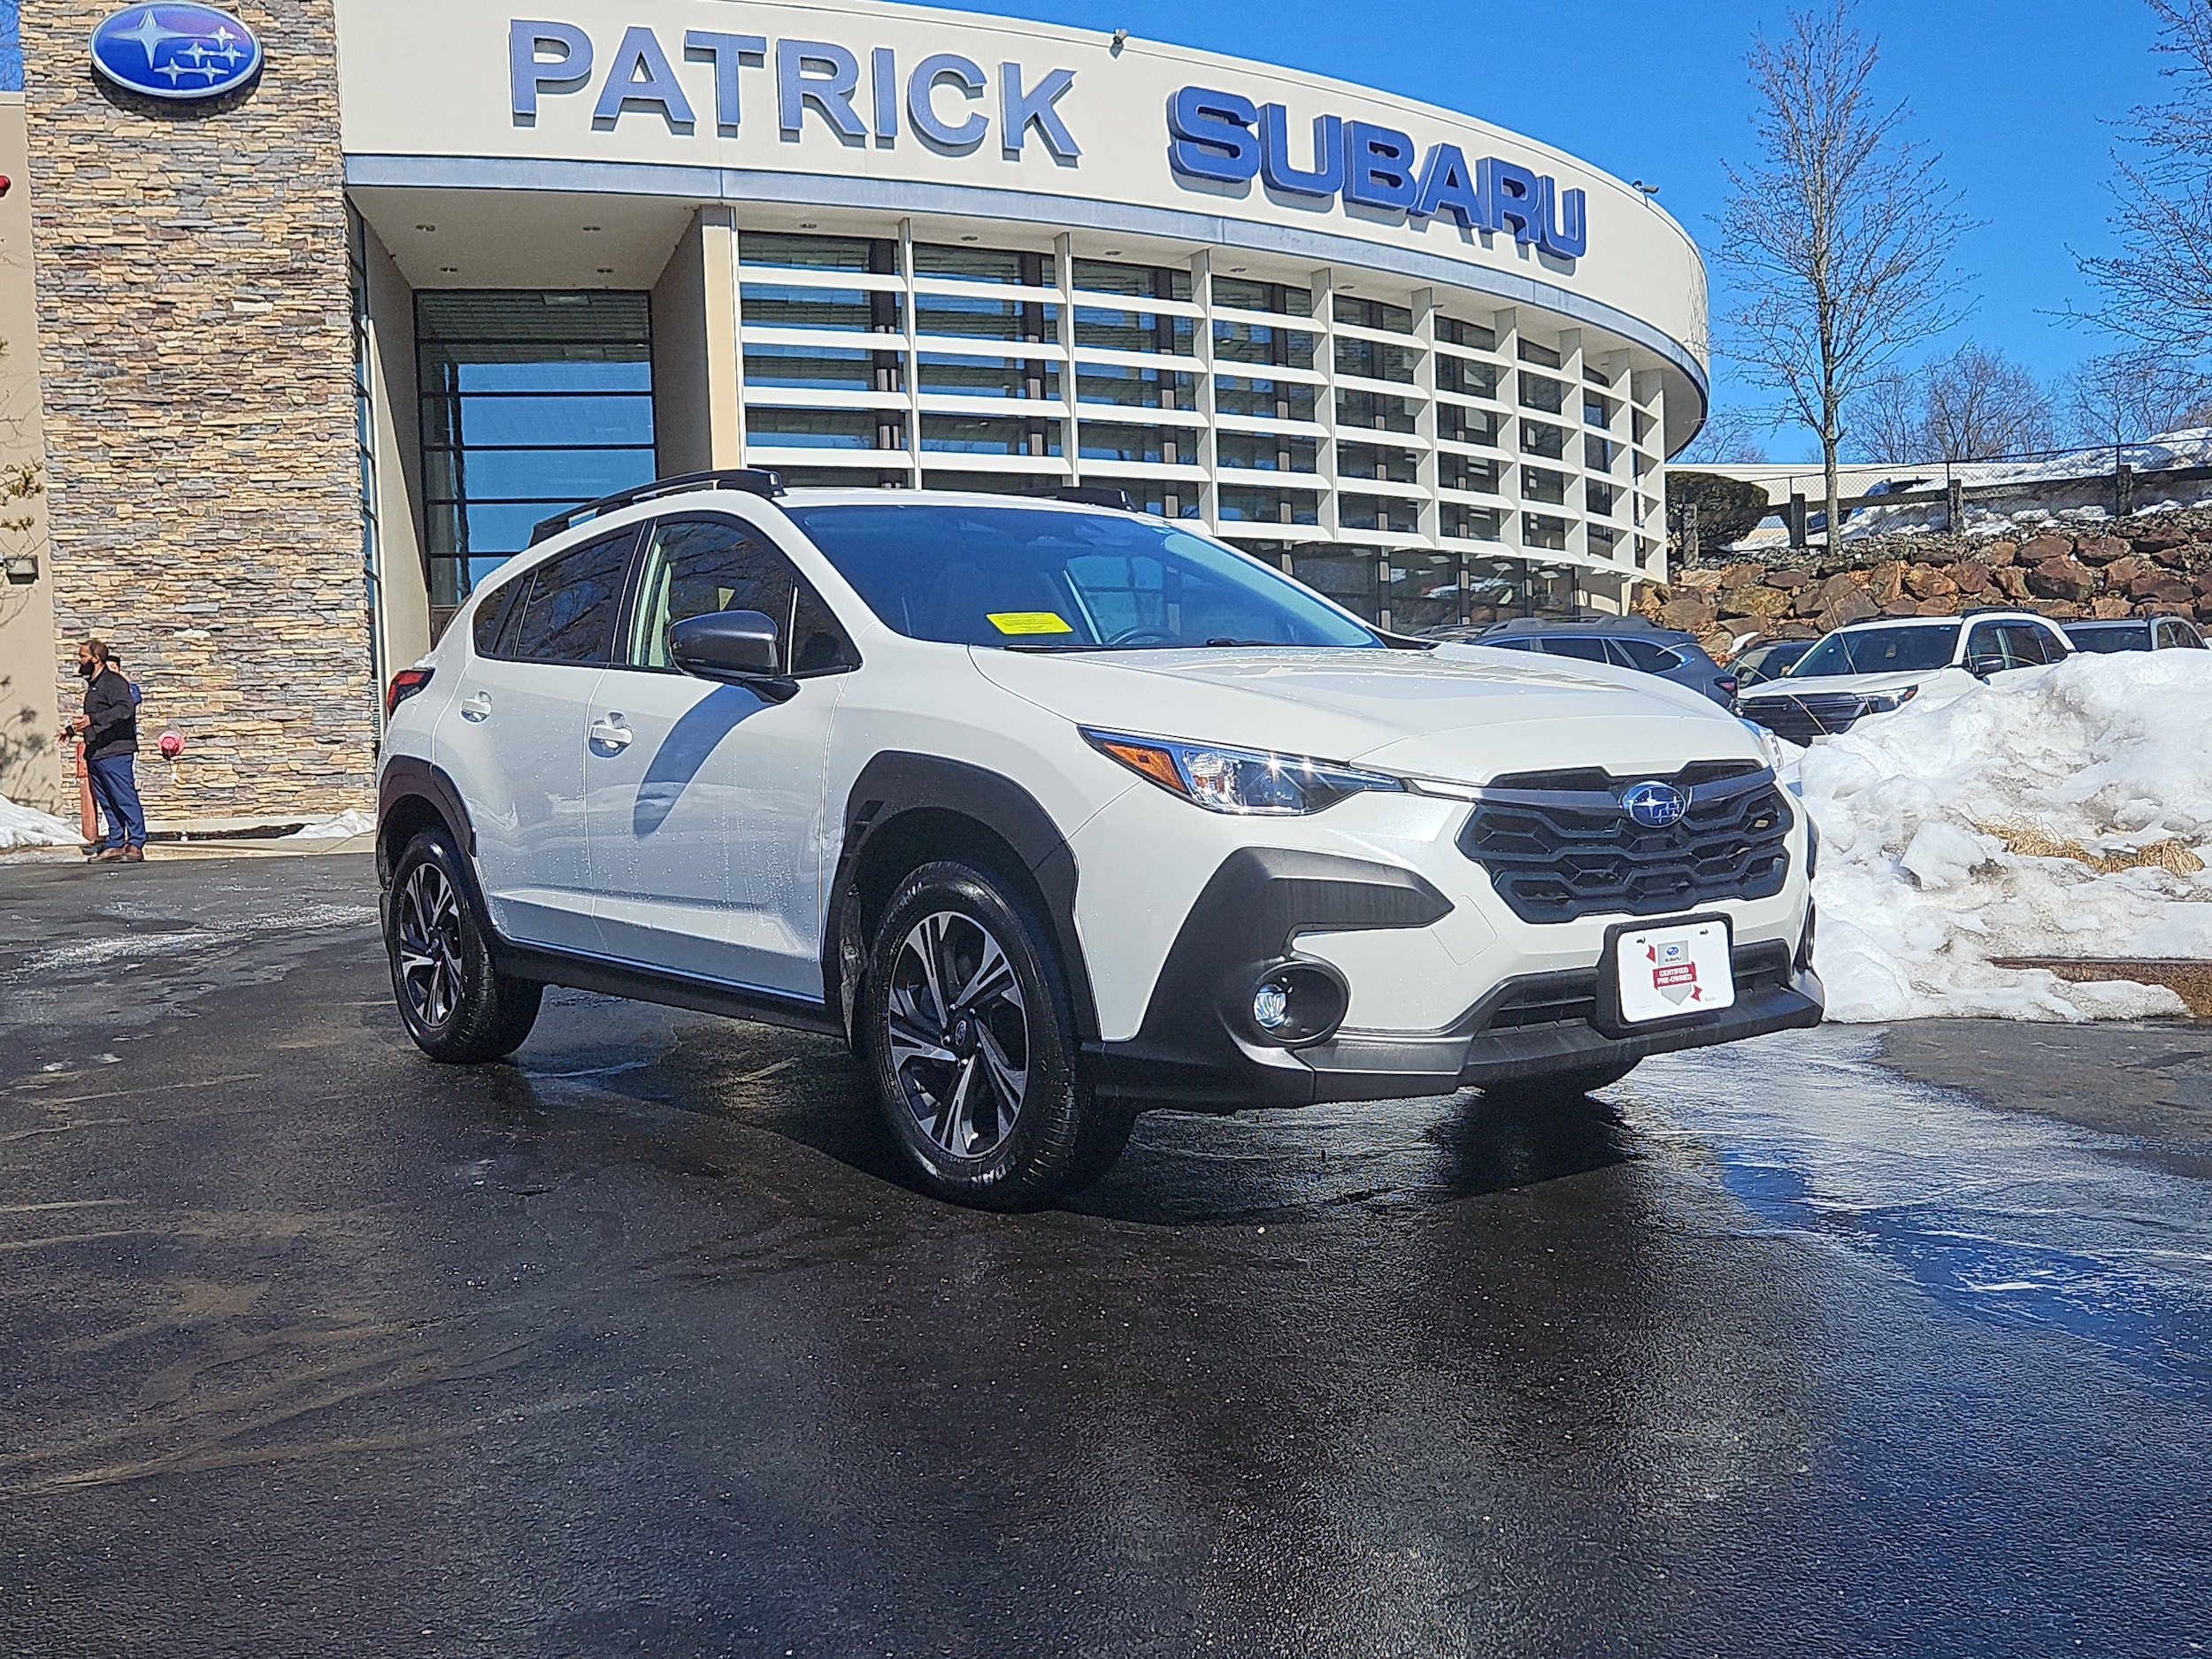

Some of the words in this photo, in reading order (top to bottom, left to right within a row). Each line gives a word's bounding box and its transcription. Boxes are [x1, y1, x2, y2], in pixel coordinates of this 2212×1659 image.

[509, 19, 1082, 165] PATRICK
[1165, 85, 1586, 262] SUBARU
[1659, 967, 1689, 977] CERTIFIED
[1657, 974, 1693, 985] PRE-OWNED
